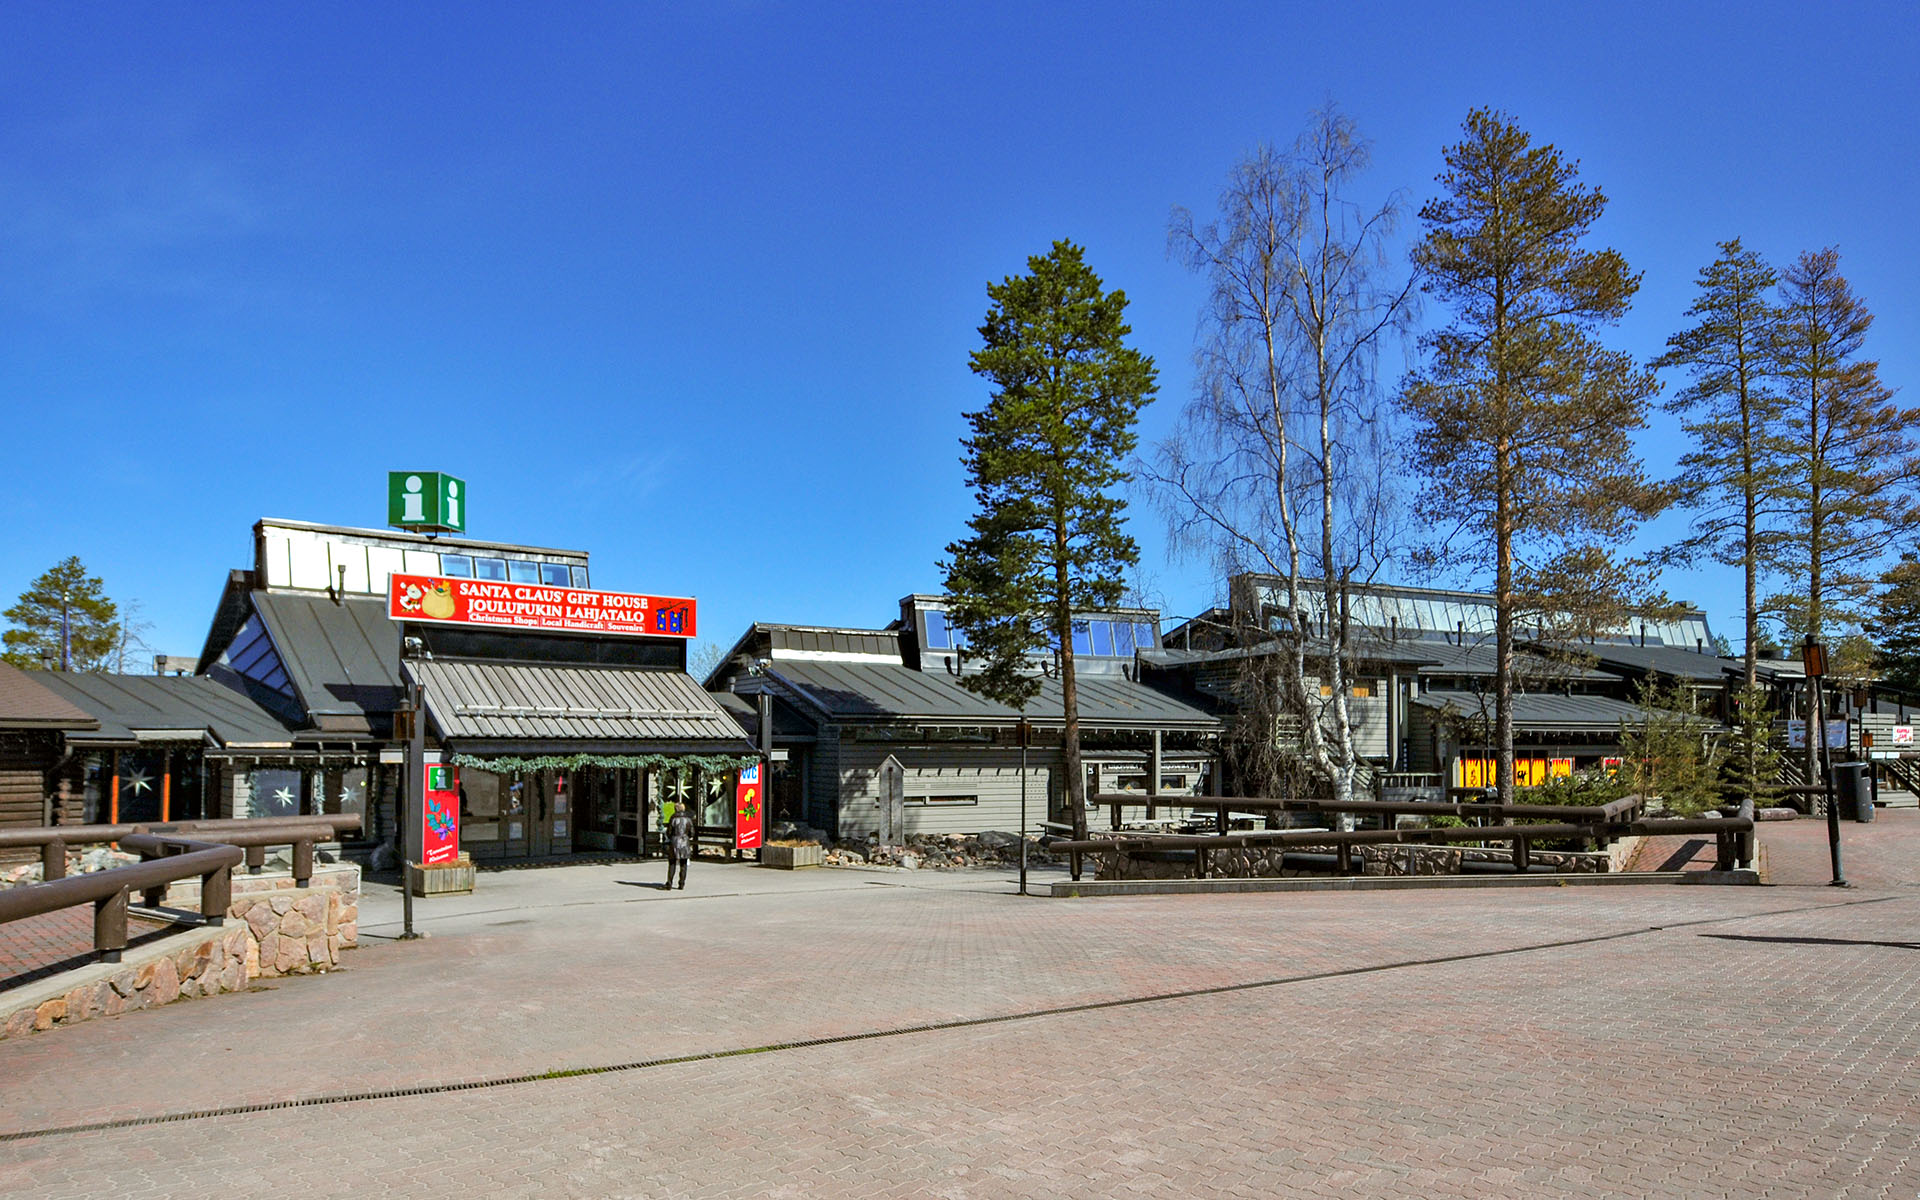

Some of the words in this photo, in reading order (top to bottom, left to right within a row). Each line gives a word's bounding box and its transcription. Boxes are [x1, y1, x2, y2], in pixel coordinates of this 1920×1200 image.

[459, 583, 512, 599] SANTA
[567, 592, 599, 605] GIFT
[603, 595, 648, 609] HOUSE
[467, 599, 562, 617] JOULUPUKIN
[566, 606, 644, 622] LAHJATALO
[469, 613, 512, 623] Christmas
[514, 616, 538, 626] Shops
[541, 618, 562, 626] Local
[564, 619, 604, 629] Handicraft
[607, 623, 643, 632] Souvenirs
[741, 767, 757, 779] WC
